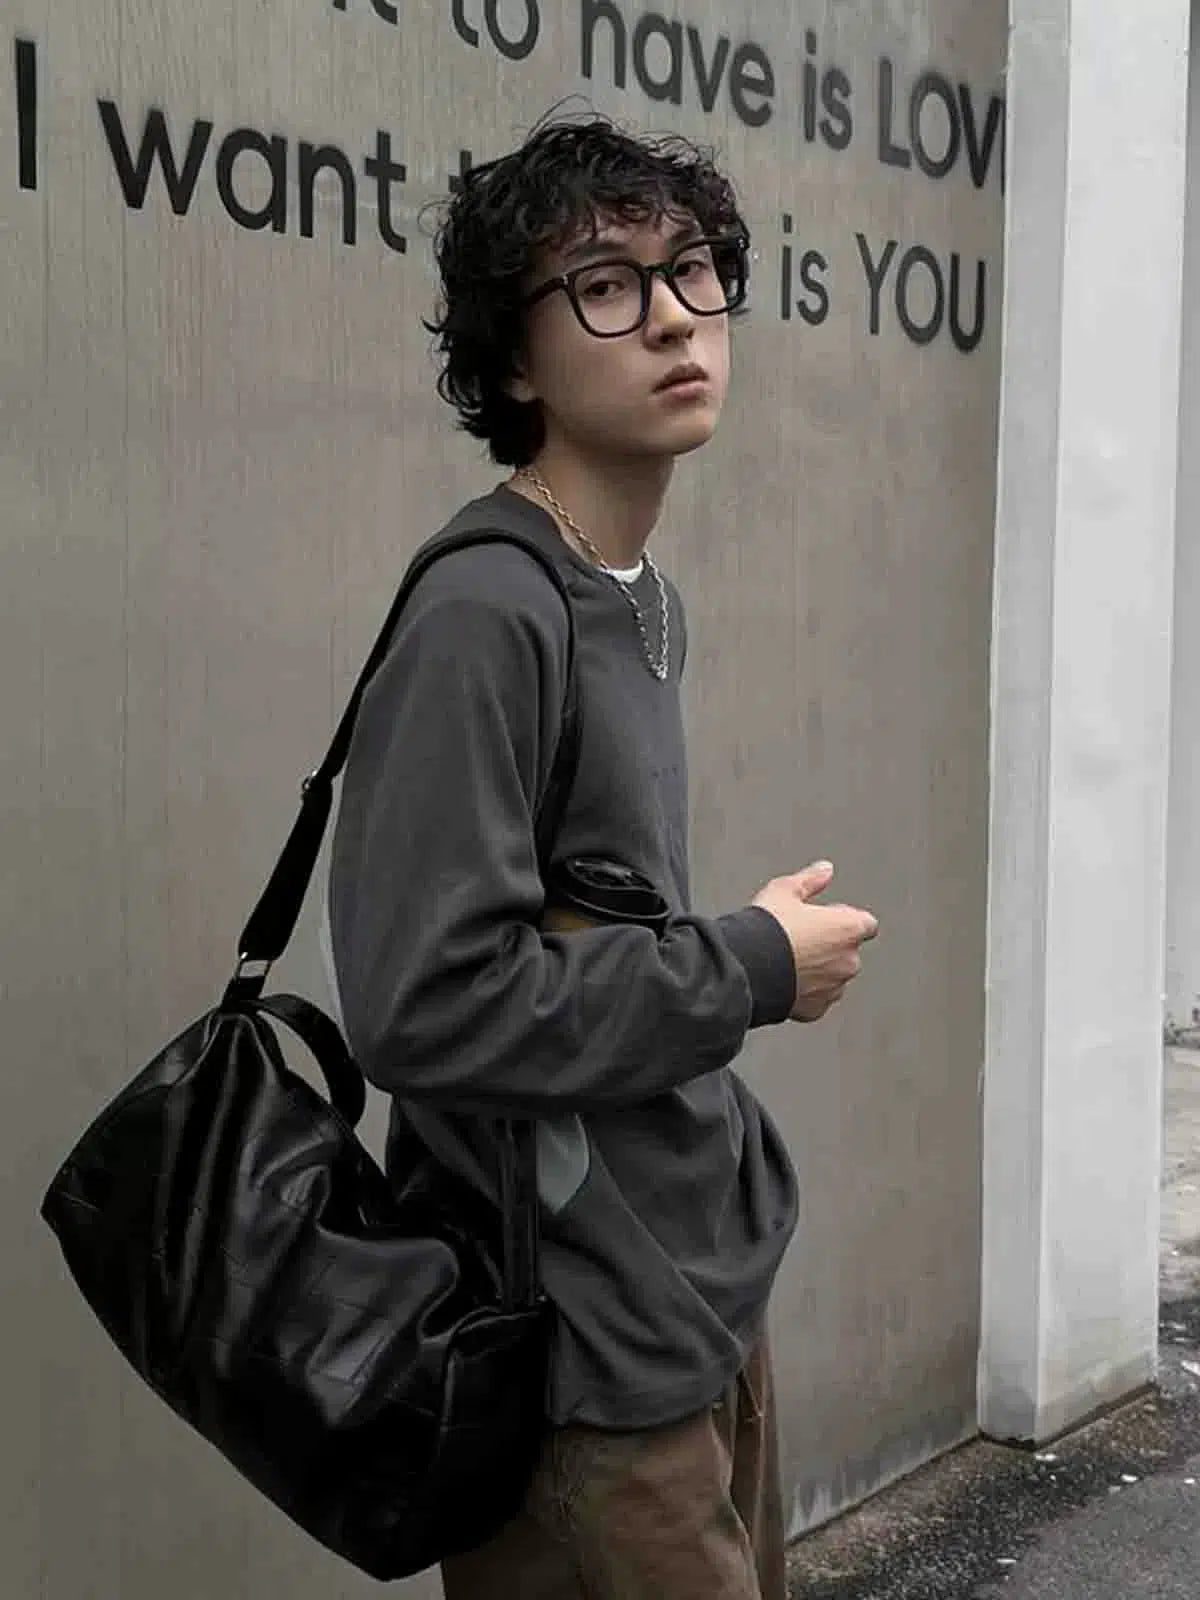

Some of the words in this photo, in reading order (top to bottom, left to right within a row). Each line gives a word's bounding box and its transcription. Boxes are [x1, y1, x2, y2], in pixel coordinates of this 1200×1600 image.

[15, 39, 37, 190] I
[97, 100, 406, 254] want
[781, 213, 829, 326] is
[856, 233, 986, 353] YOU
[581, 0, 775, 127] have
[803, 30, 853, 150] is
[878, 57, 1006, 199] LOV
